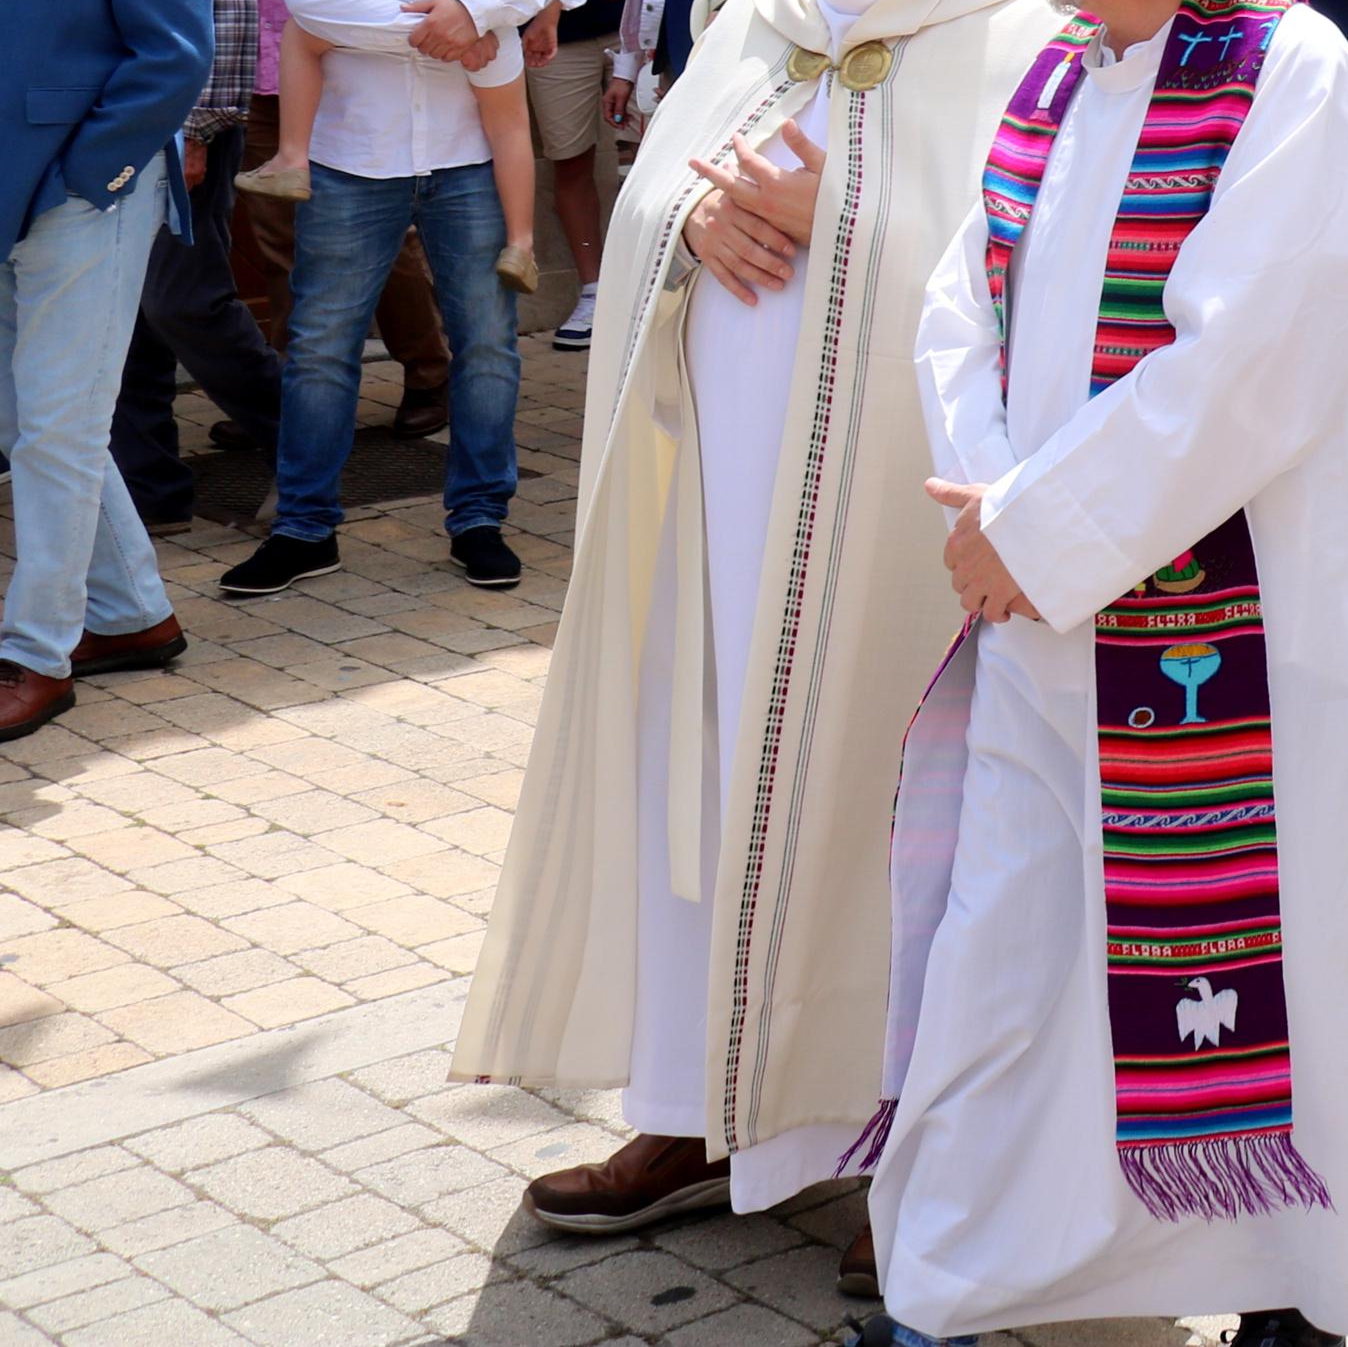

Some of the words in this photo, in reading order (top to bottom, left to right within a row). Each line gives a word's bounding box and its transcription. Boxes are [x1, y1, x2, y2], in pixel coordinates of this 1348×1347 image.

[1147, 613, 1196, 628] FLORA
[1122, 943, 1172, 957] FLORA
[1201, 938, 1246, 954] FLORA
